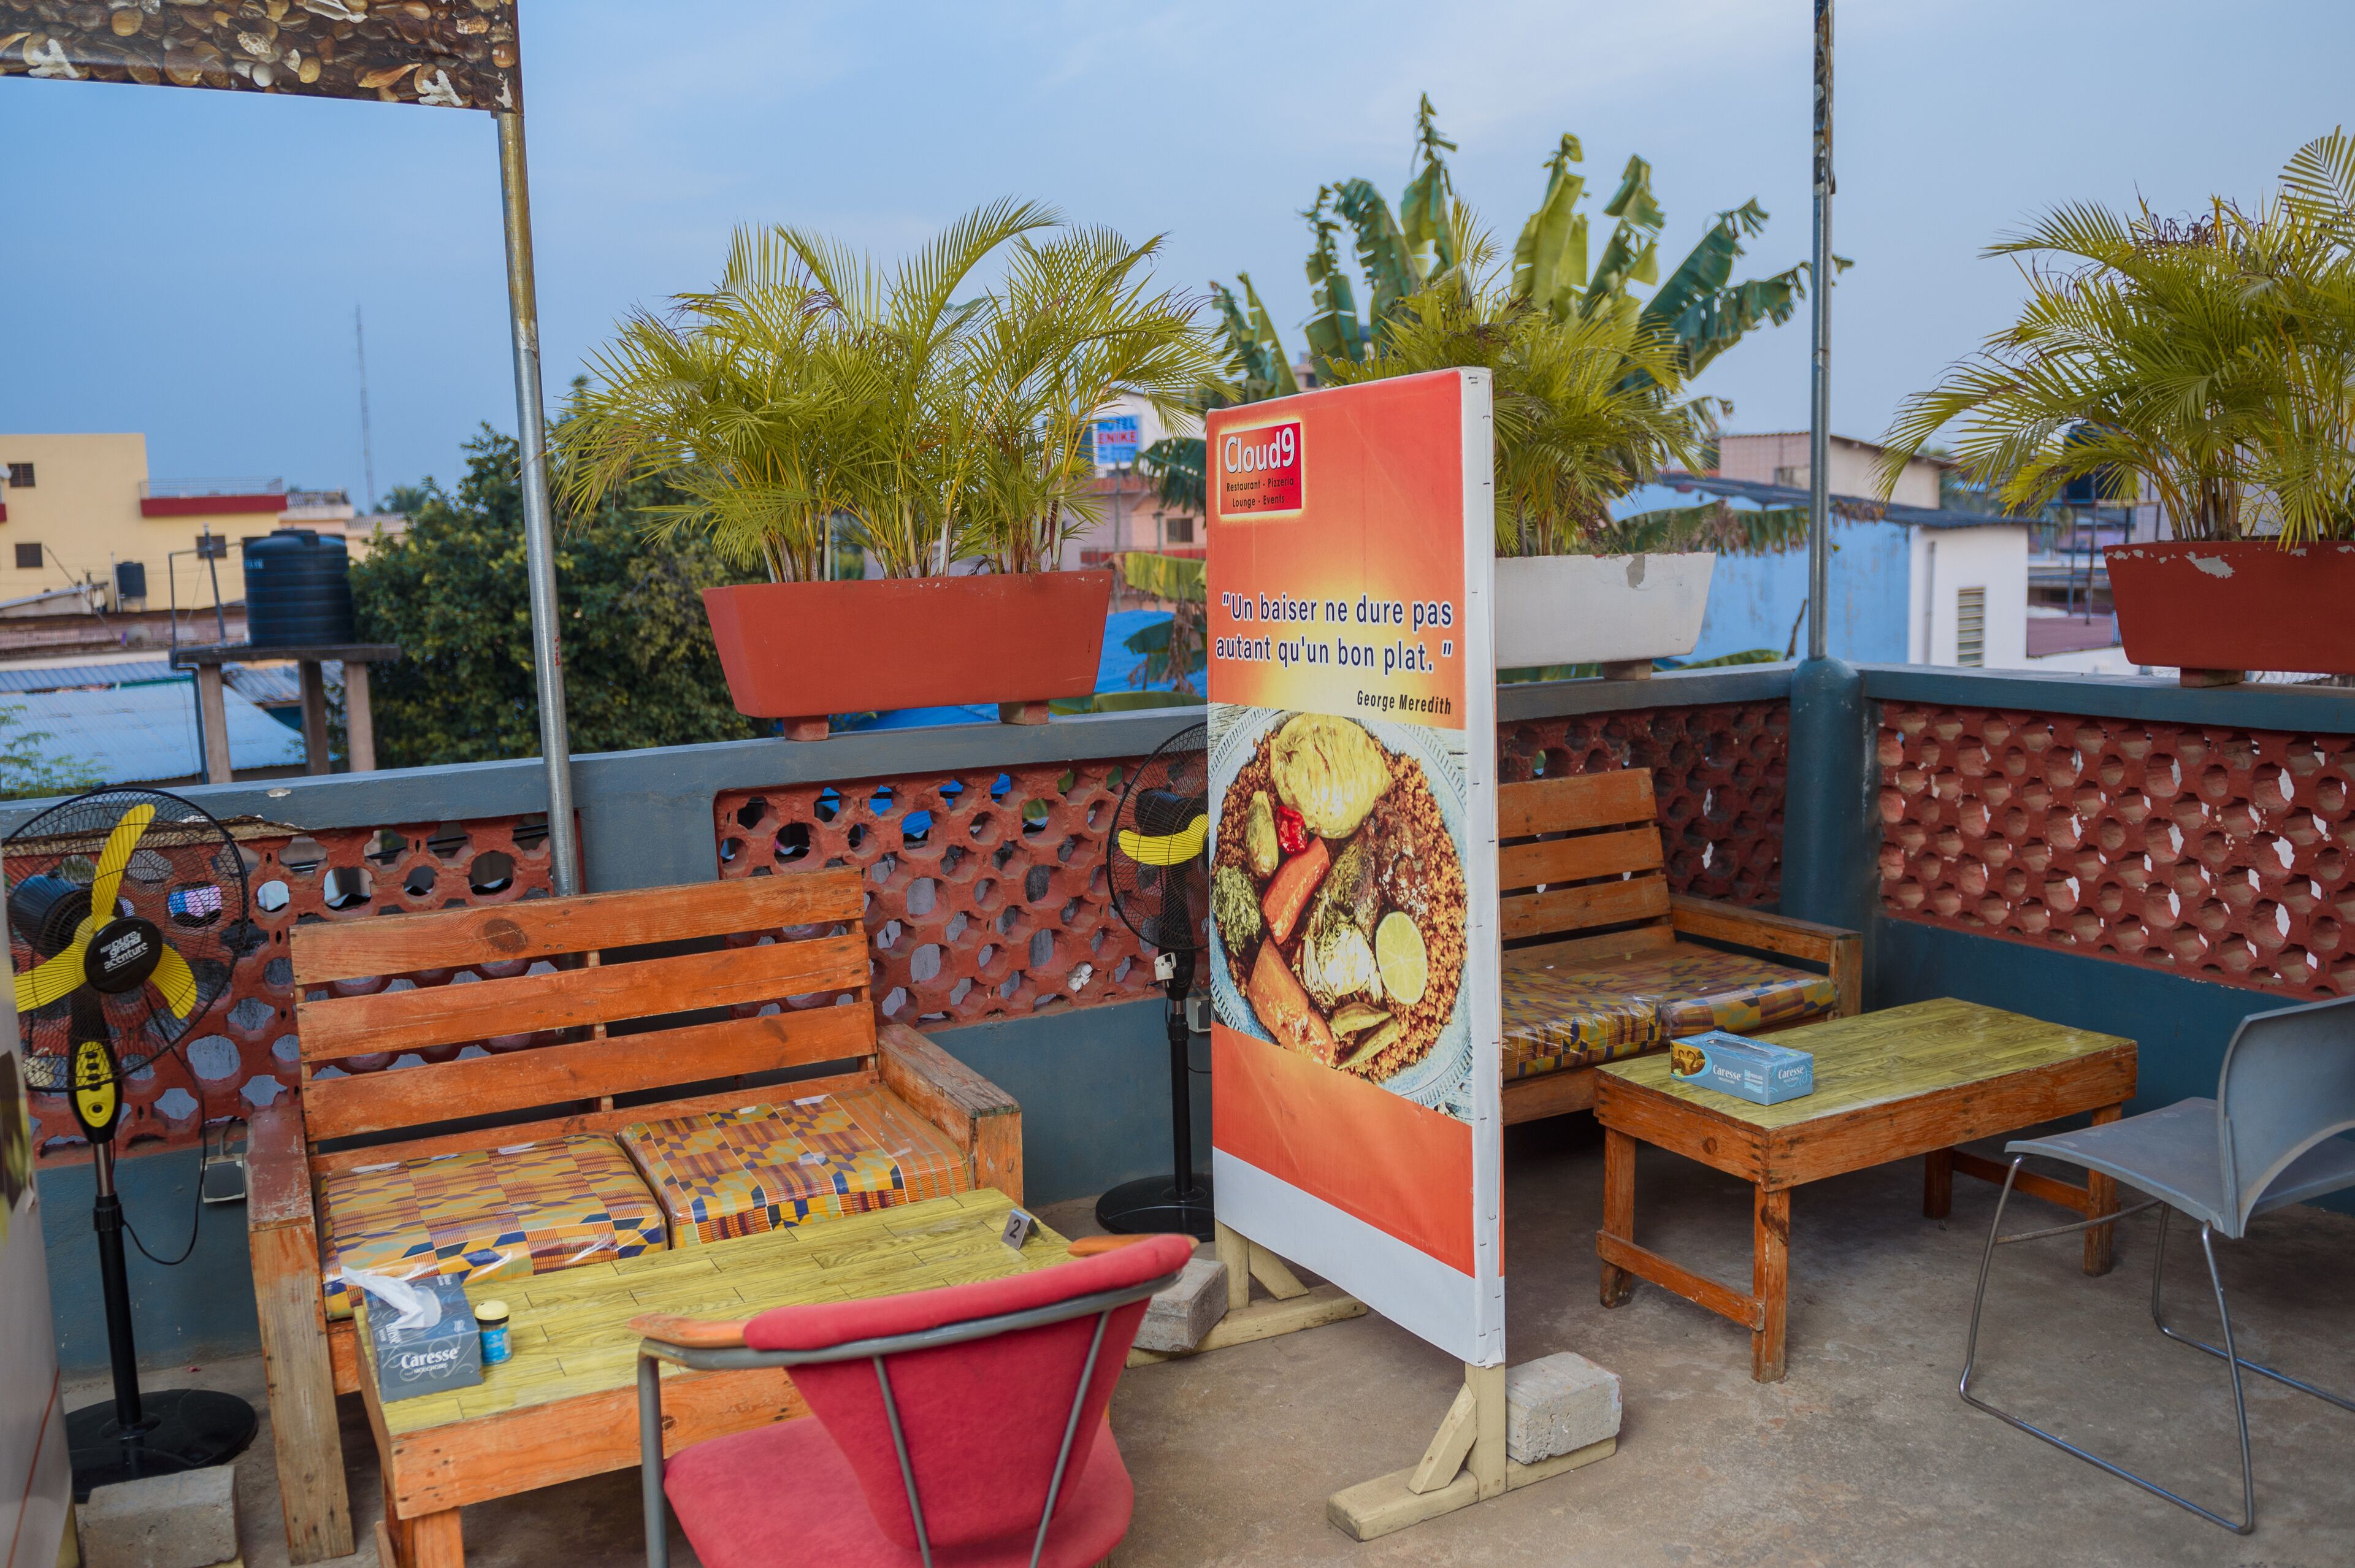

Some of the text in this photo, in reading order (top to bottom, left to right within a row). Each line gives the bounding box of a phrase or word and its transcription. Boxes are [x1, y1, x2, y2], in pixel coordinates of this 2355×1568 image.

[1098, 430, 1137, 445] ENIKE
[1225, 427, 1295, 473] Cloud9
[1227, 480, 1260, 492] Restaurant
[1268, 476, 1294, 488] Pizzeria
[1232, 497, 1255, 508] Lounge
[1263, 494, 1285, 505] Events
[1223, 594, 1452, 632] "Un baiser ne dure pas
[1217, 635, 1271, 660] autant
[1278, 636, 1328, 668] qu'un
[1338, 638, 1374, 666] bon
[1357, 690, 1451, 715] George Meredith
[104, 942, 149, 969] acenture
[1712, 1064, 1742, 1081] Caresse
[1779, 1066, 1804, 1079] Caresse
[1009, 1218, 1021, 1239] 2
[401, 1347, 460, 1369] Caresse
